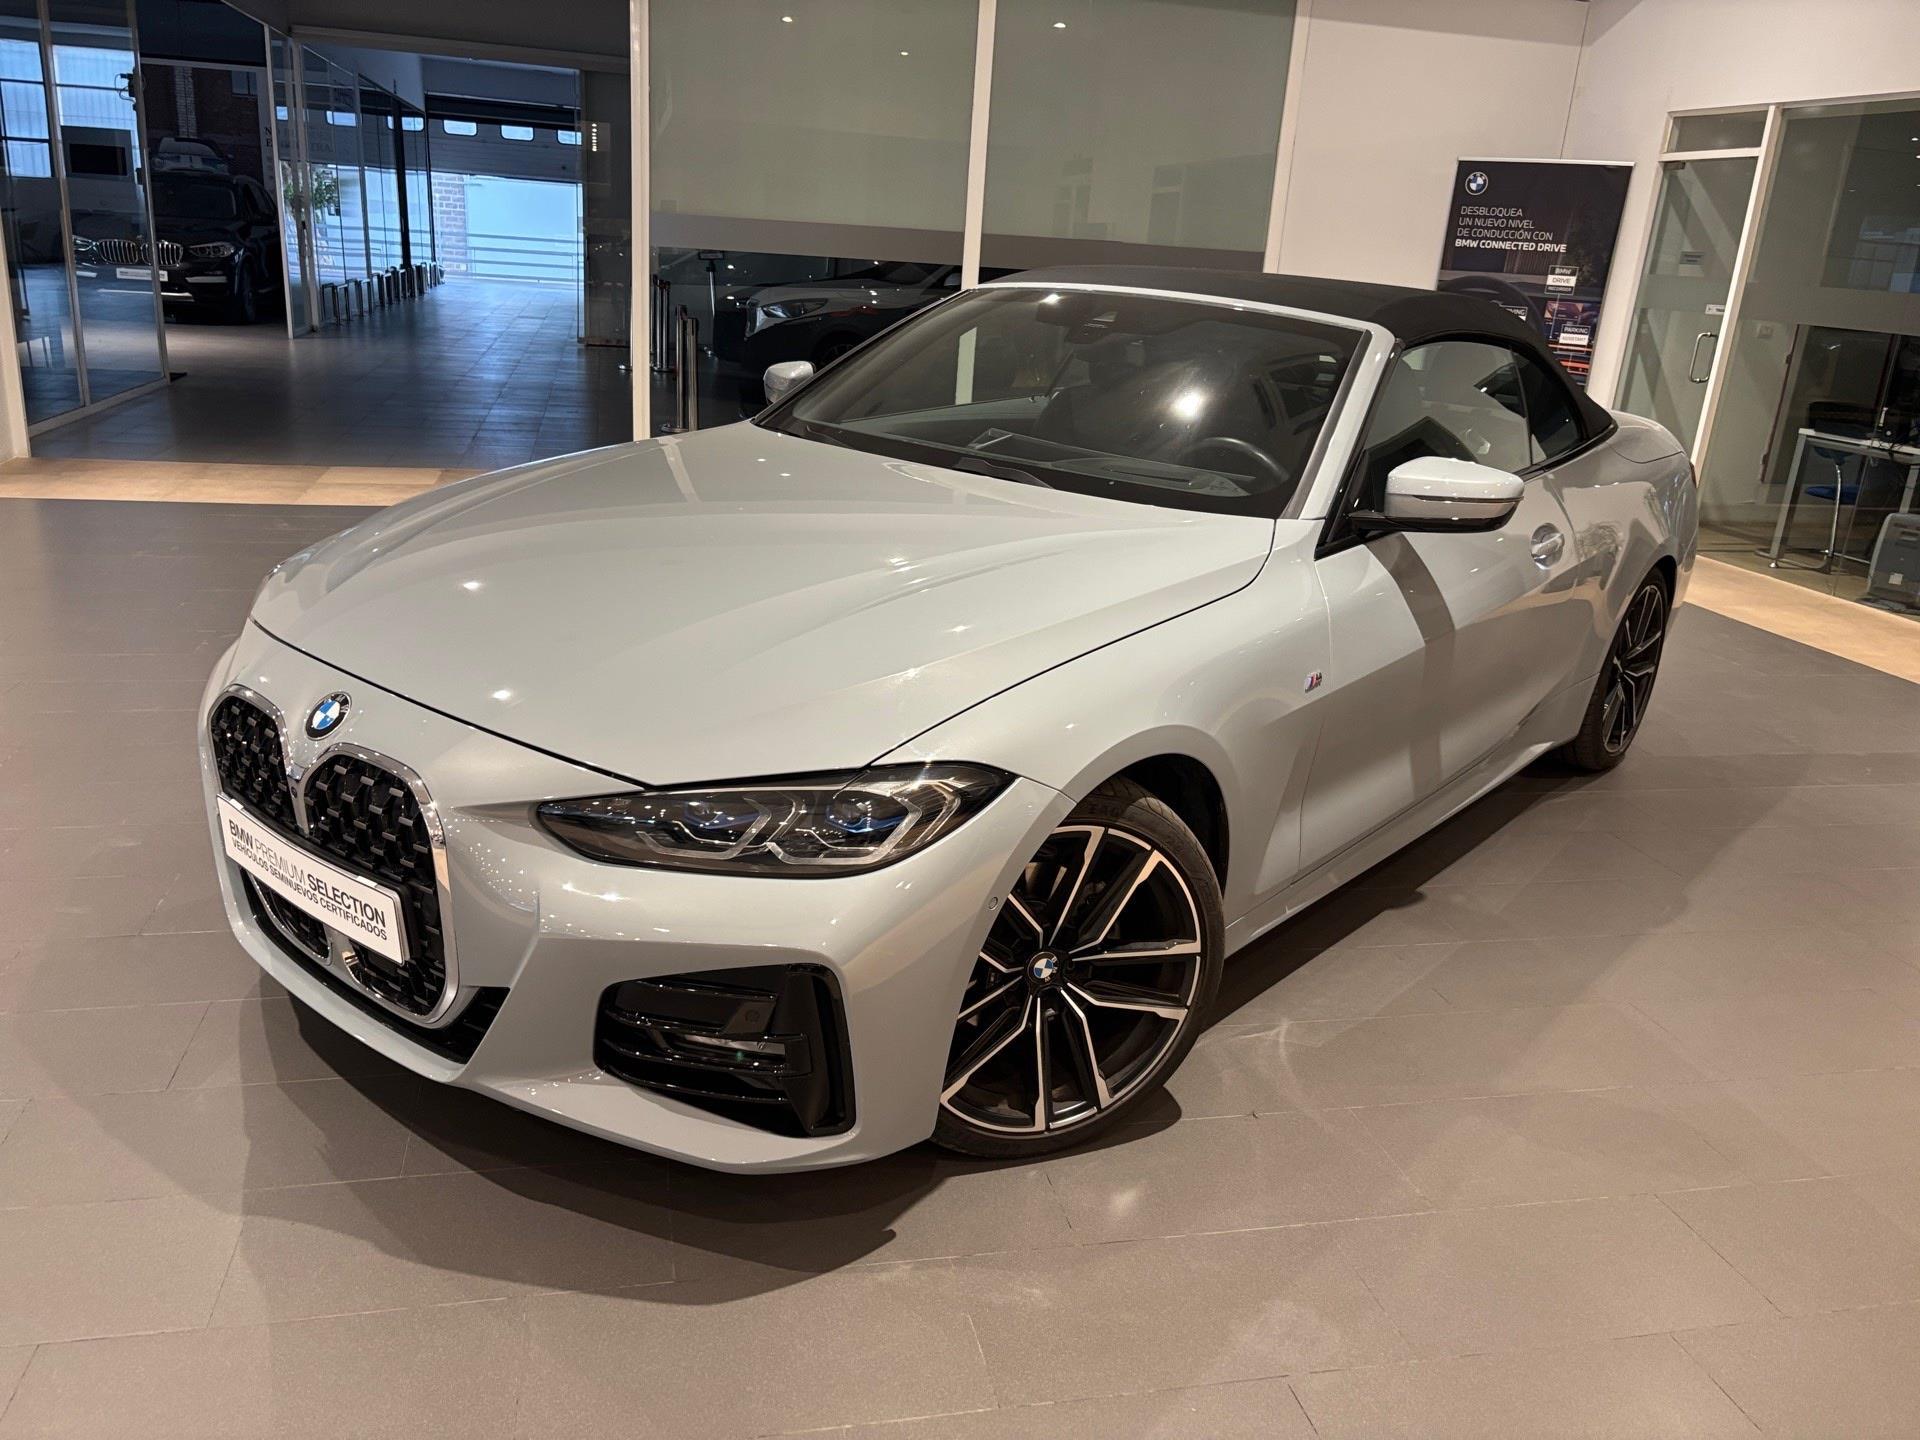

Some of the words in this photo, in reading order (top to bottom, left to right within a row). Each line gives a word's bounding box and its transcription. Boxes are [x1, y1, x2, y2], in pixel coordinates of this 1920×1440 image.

[1460, 206, 1523, 217] DESBLOQUEA
[1458, 217, 1473, 226] UN
[1474, 218, 1507, 228] NUEVO
[1508, 220, 1535, 229] NIVEL
[1457, 228, 1471, 237] DE
[1471, 228, 1532, 240] CONDUCCIÓN
[1532, 231, 1554, 240] CON
[1455, 239, 1479, 248] BMW
[1480, 240, 1536, 251] CONNECTED
[1537, 242, 1567, 253] DRIVE
[1552, 277, 1572, 285] DRIVE
[228, 819, 254, 849] BMW
[254, 838, 305, 886] PREMIUM
[307, 873, 387, 928] SELECTION
[269, 864, 319, 905] SEMINUEVOS
[319, 898, 388, 941] CERTIFICADOS
